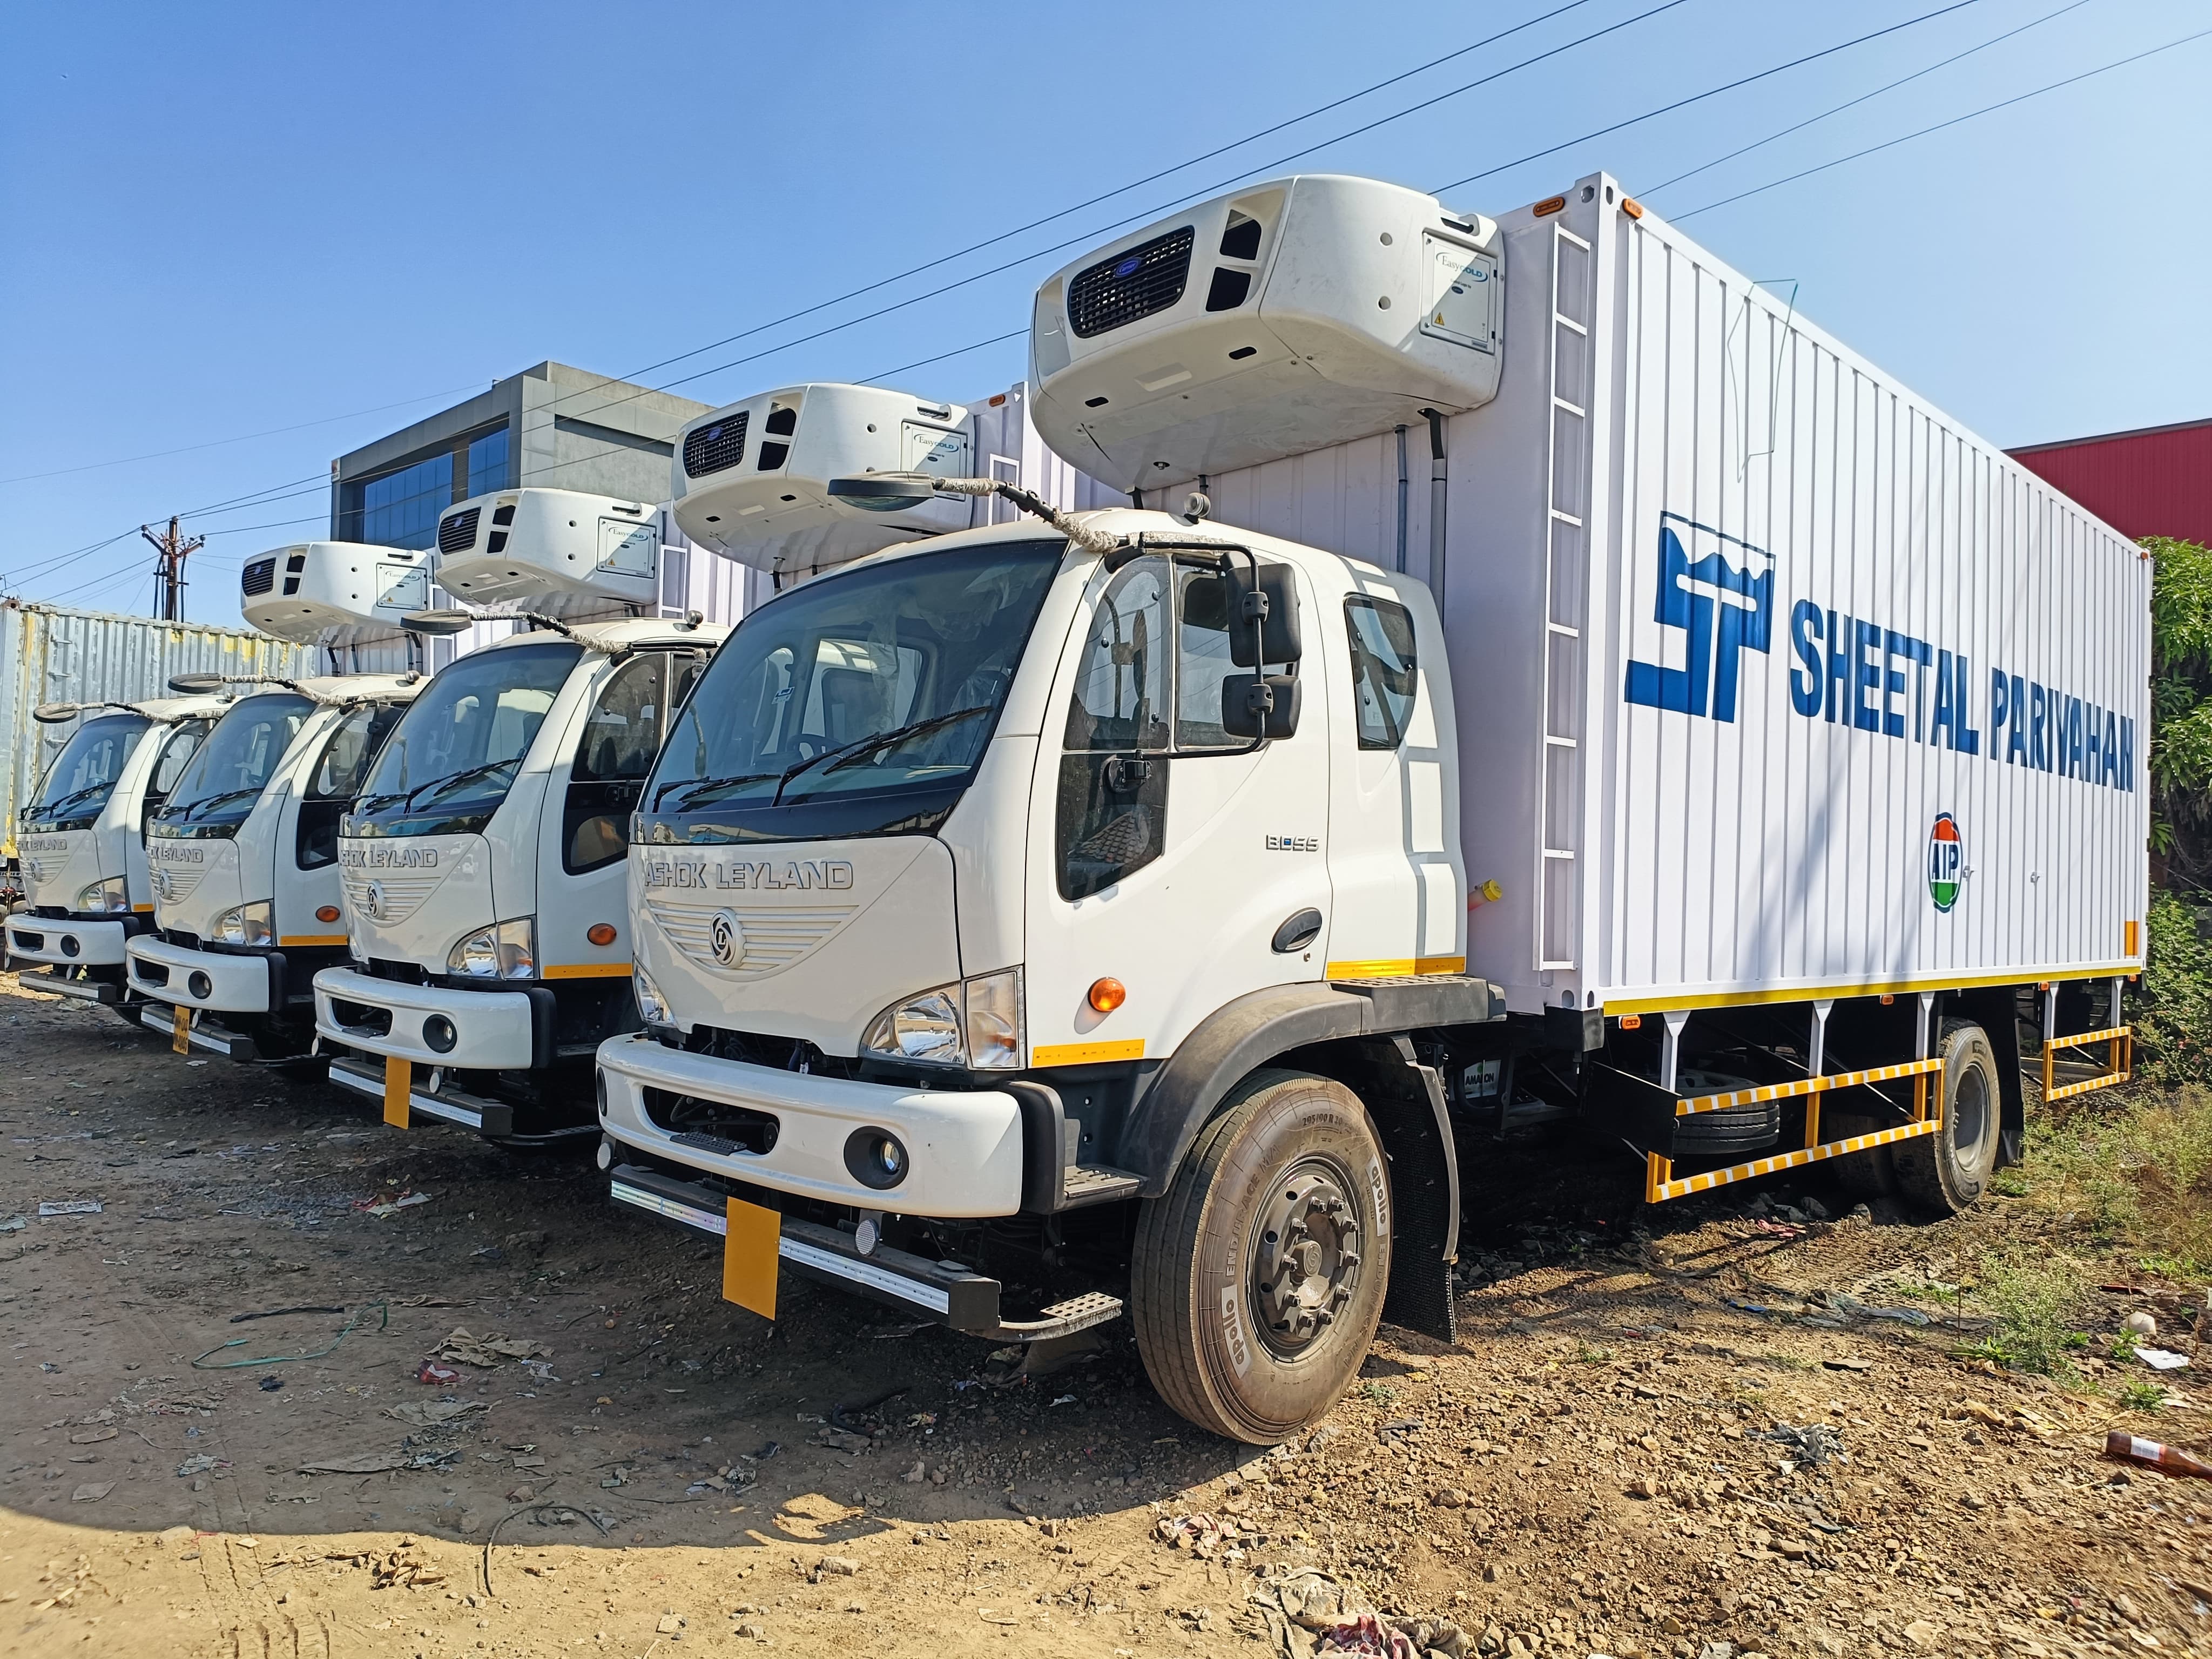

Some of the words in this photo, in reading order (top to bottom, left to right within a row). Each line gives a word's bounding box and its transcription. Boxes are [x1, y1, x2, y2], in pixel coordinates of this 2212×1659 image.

[1790, 599, 1979, 756] SHEETAL
[1990, 666, 2134, 793] PARIVAHAN
[31, 839, 67, 851] LEYLAND
[161, 847, 204, 863] LEYLAND
[1266, 834, 1318, 852] BOSS
[369, 848, 438, 868] LEYLAND
[1932, 843, 1959, 880] AIP
[644, 861, 707, 889] ASHOK
[716, 861, 854, 890] LEYLAND
[1371, 1165, 1387, 1225] apollo
[1222, 1299, 1244, 1365] apollo
